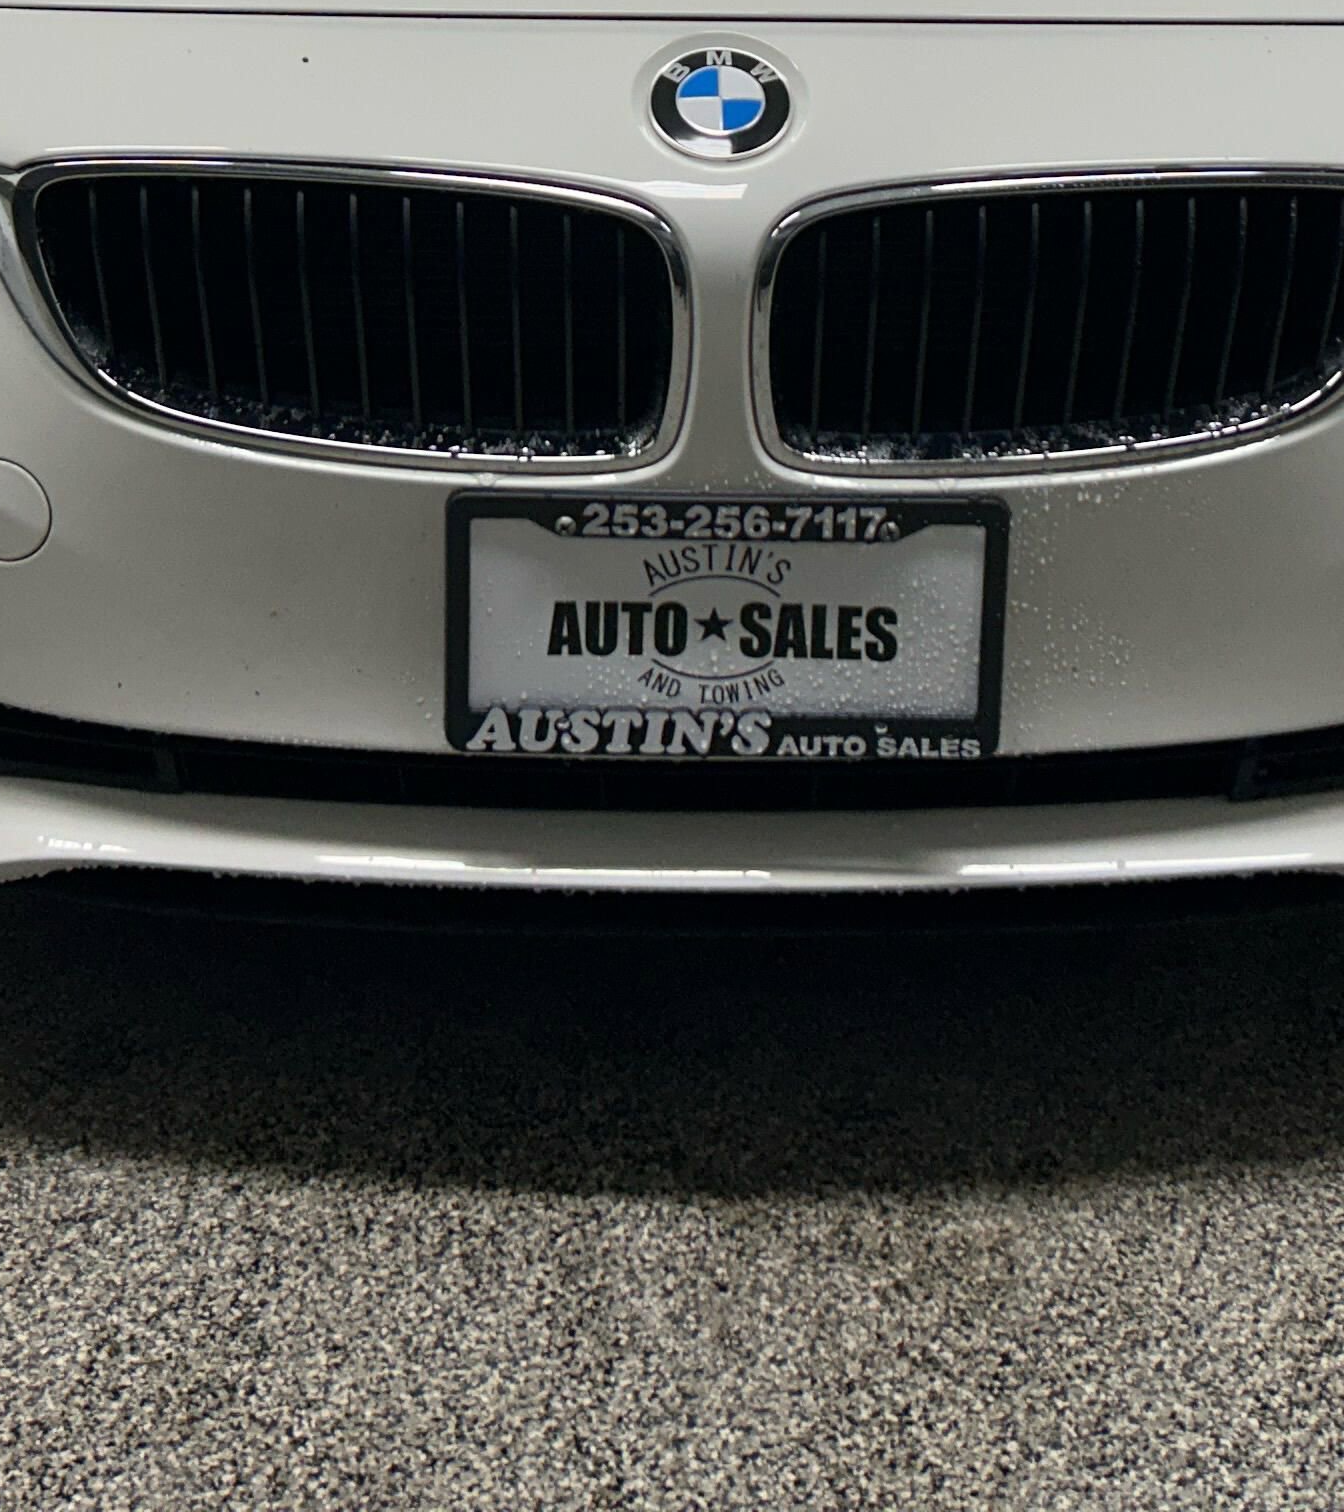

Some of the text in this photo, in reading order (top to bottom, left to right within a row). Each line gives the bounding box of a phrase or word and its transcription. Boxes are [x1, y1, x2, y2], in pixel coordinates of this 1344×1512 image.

[661, 49, 780, 84] BMW
[582, 502, 886, 542] 253-256-7117
[642, 543, 791, 587] AUSTIN'S
[547, 600, 898, 662] AUTO SALES
[637, 668, 785, 705] AND TOWING
[466, 705, 982, 759] AUSTIN'S AUTO SALES
